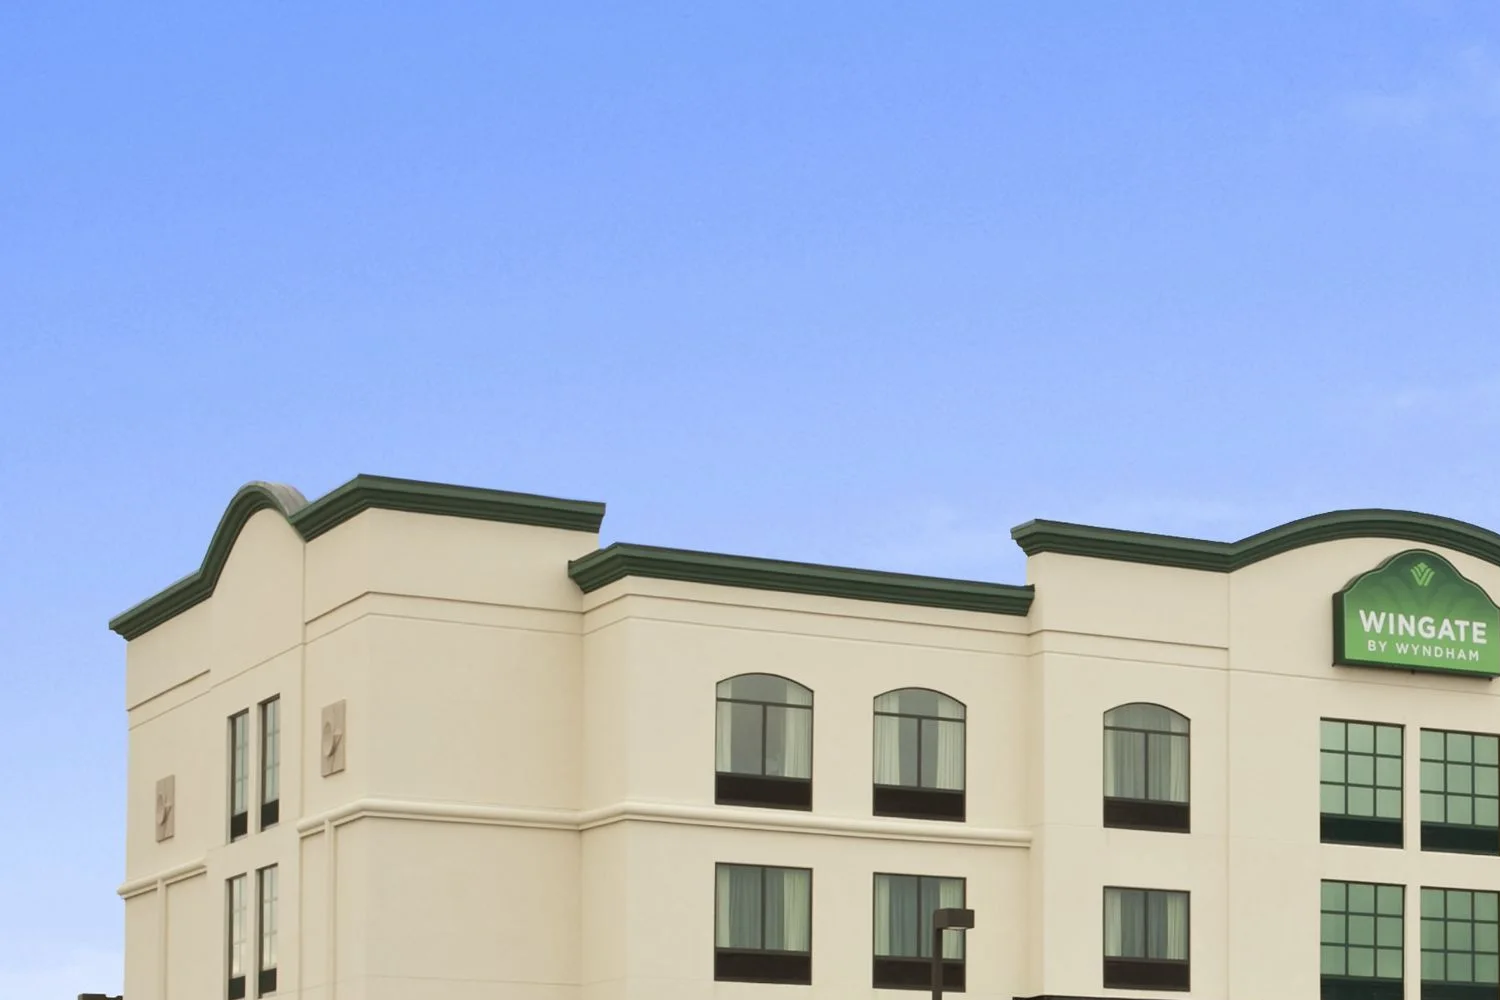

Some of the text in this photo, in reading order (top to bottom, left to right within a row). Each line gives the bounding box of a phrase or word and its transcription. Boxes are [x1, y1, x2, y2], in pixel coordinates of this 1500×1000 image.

[1359, 609, 1487, 644] WINGATE
[1367, 640, 1479, 661] BY WYNDHAM
